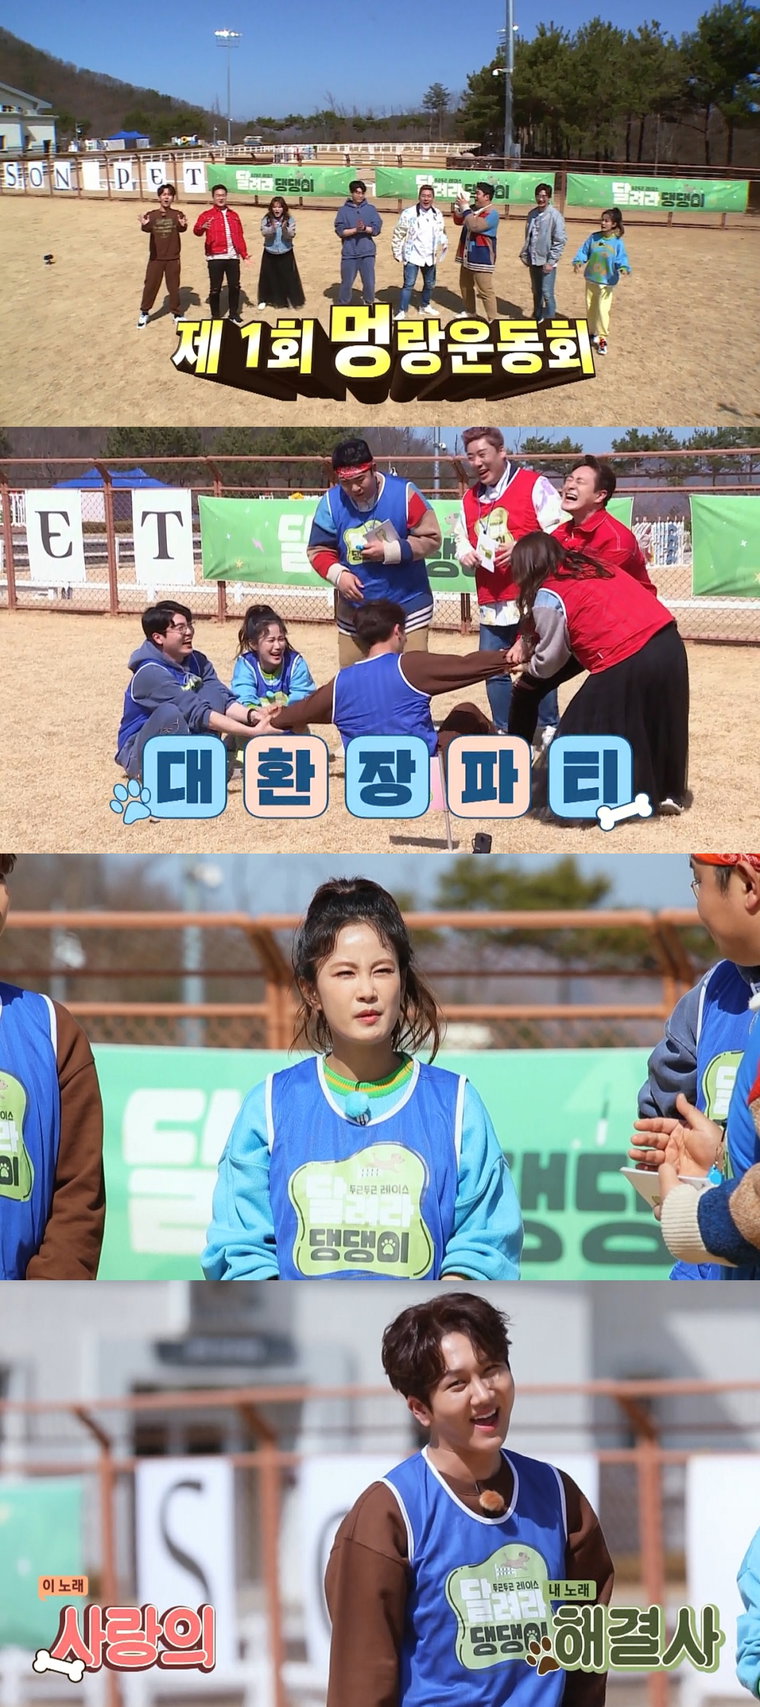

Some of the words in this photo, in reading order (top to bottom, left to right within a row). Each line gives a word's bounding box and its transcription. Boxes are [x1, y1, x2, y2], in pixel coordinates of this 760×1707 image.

[6, 163, 70, 187] SON
[116, 168, 201, 189] PET
[236, 170, 274, 191] 달려라
[275, 178, 314, 192] 댕댕이
[612, 182, 660, 206] 달려라
[661, 192, 705, 207] 댕댕이
[306, 1175, 414, 1228] 달려라
[349, 1184, 378, 1195] 두근두근
[380, 1184, 409, 1195] 레이스
[309, 1228, 410, 1264] 댕댕이
[492, 1583, 515, 1592] 두근두근
[516, 1581, 540, 1591] 레이스
[459, 1578, 547, 1623] 달려라
[470, 1621, 548, 1656] 댕댕이
